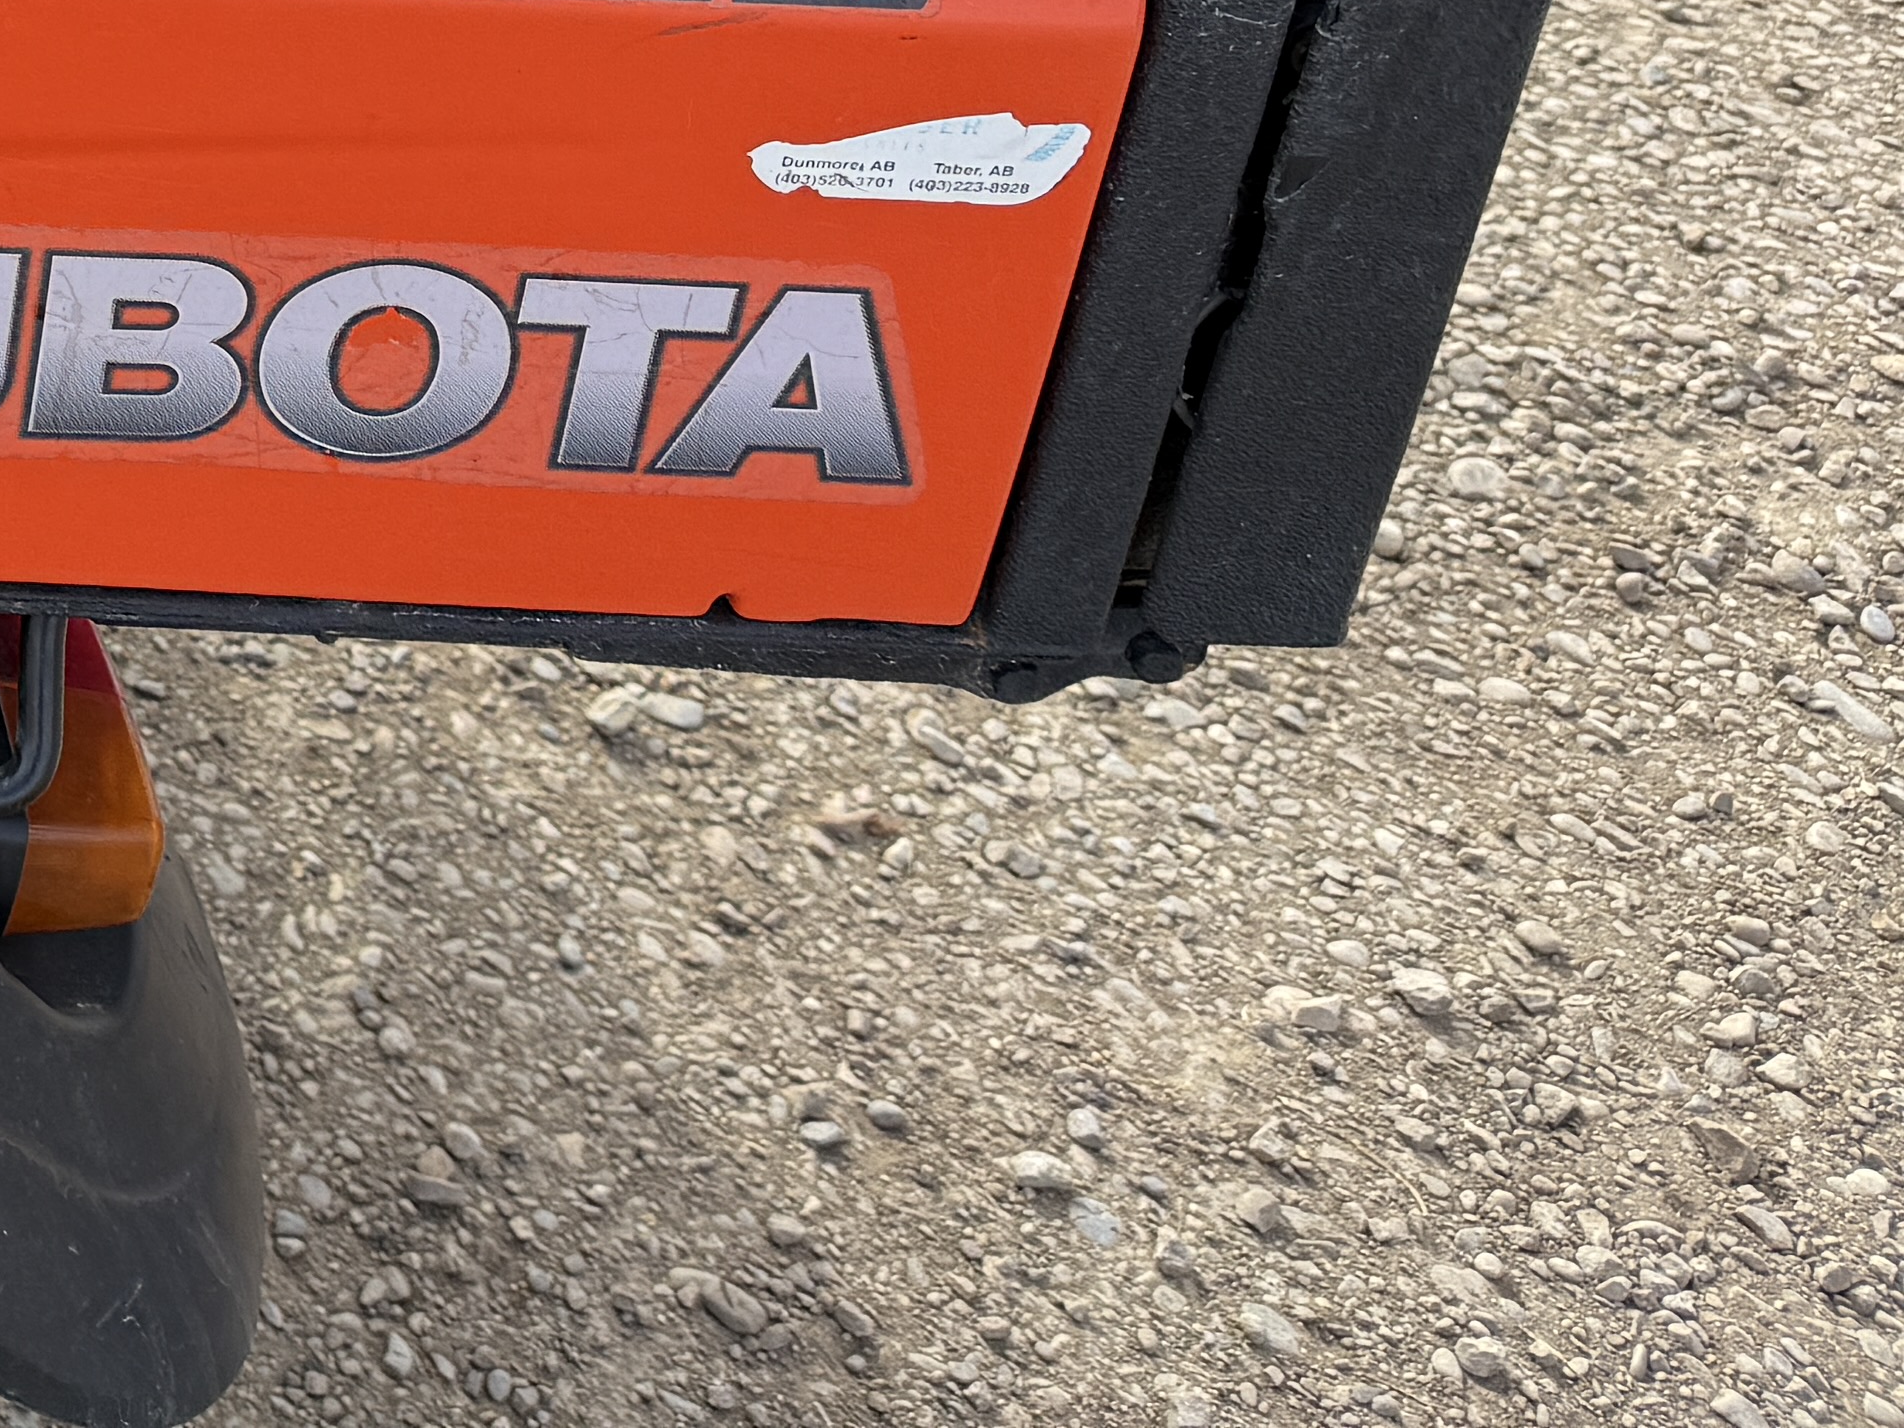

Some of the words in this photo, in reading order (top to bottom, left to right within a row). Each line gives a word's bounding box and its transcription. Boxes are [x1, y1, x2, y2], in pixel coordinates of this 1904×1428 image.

[869, 160, 896, 172] AB
[933, 162, 983, 177] Taber,
[988, 165, 1015, 177] AB
